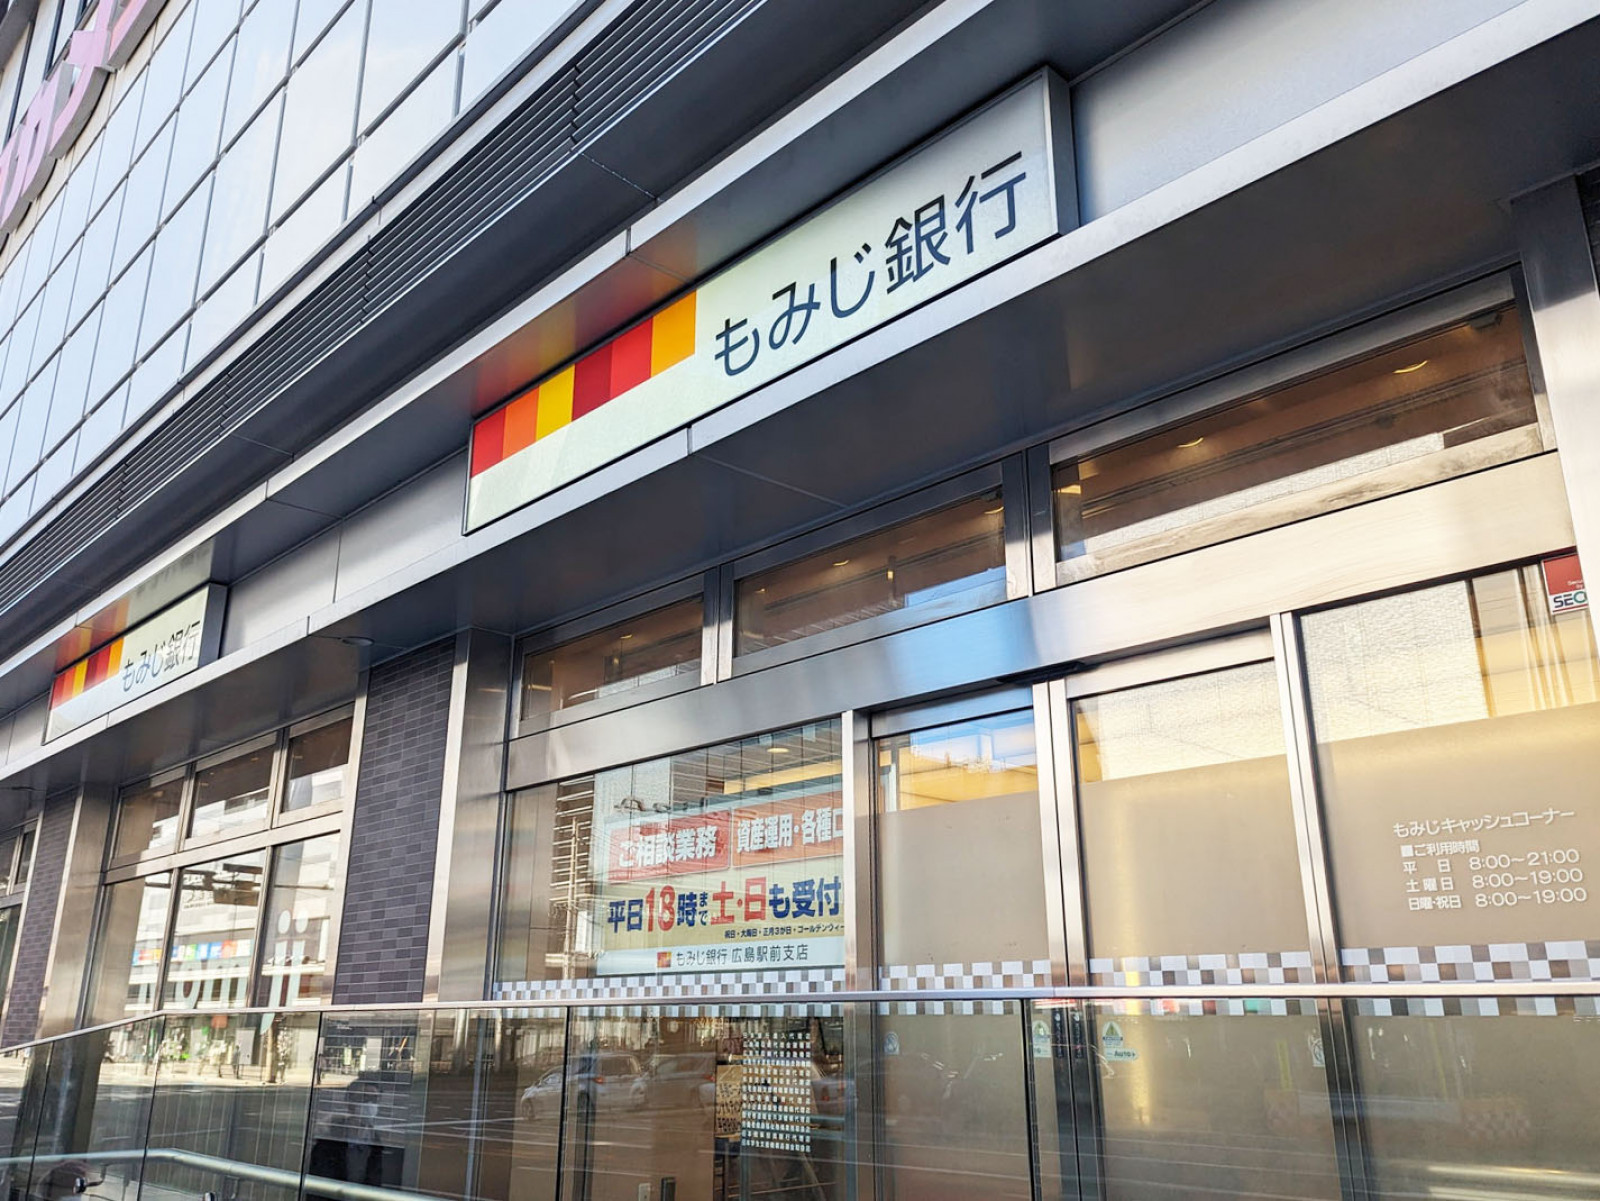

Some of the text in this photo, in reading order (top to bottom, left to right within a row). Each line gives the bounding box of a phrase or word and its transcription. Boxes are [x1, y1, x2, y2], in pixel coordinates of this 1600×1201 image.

[714, 151, 1026, 376] もみじ銀行
[123, 620, 200, 692] もみじ銀行
[1393, 808, 1575, 838] もみじキャッシュコーナー
[619, 825, 717, 868] ご相談業務
[1414, 839, 1480, 857] ご利用時間
[676, 944, 809, 966] もみじ銀行 広島駅前支店
